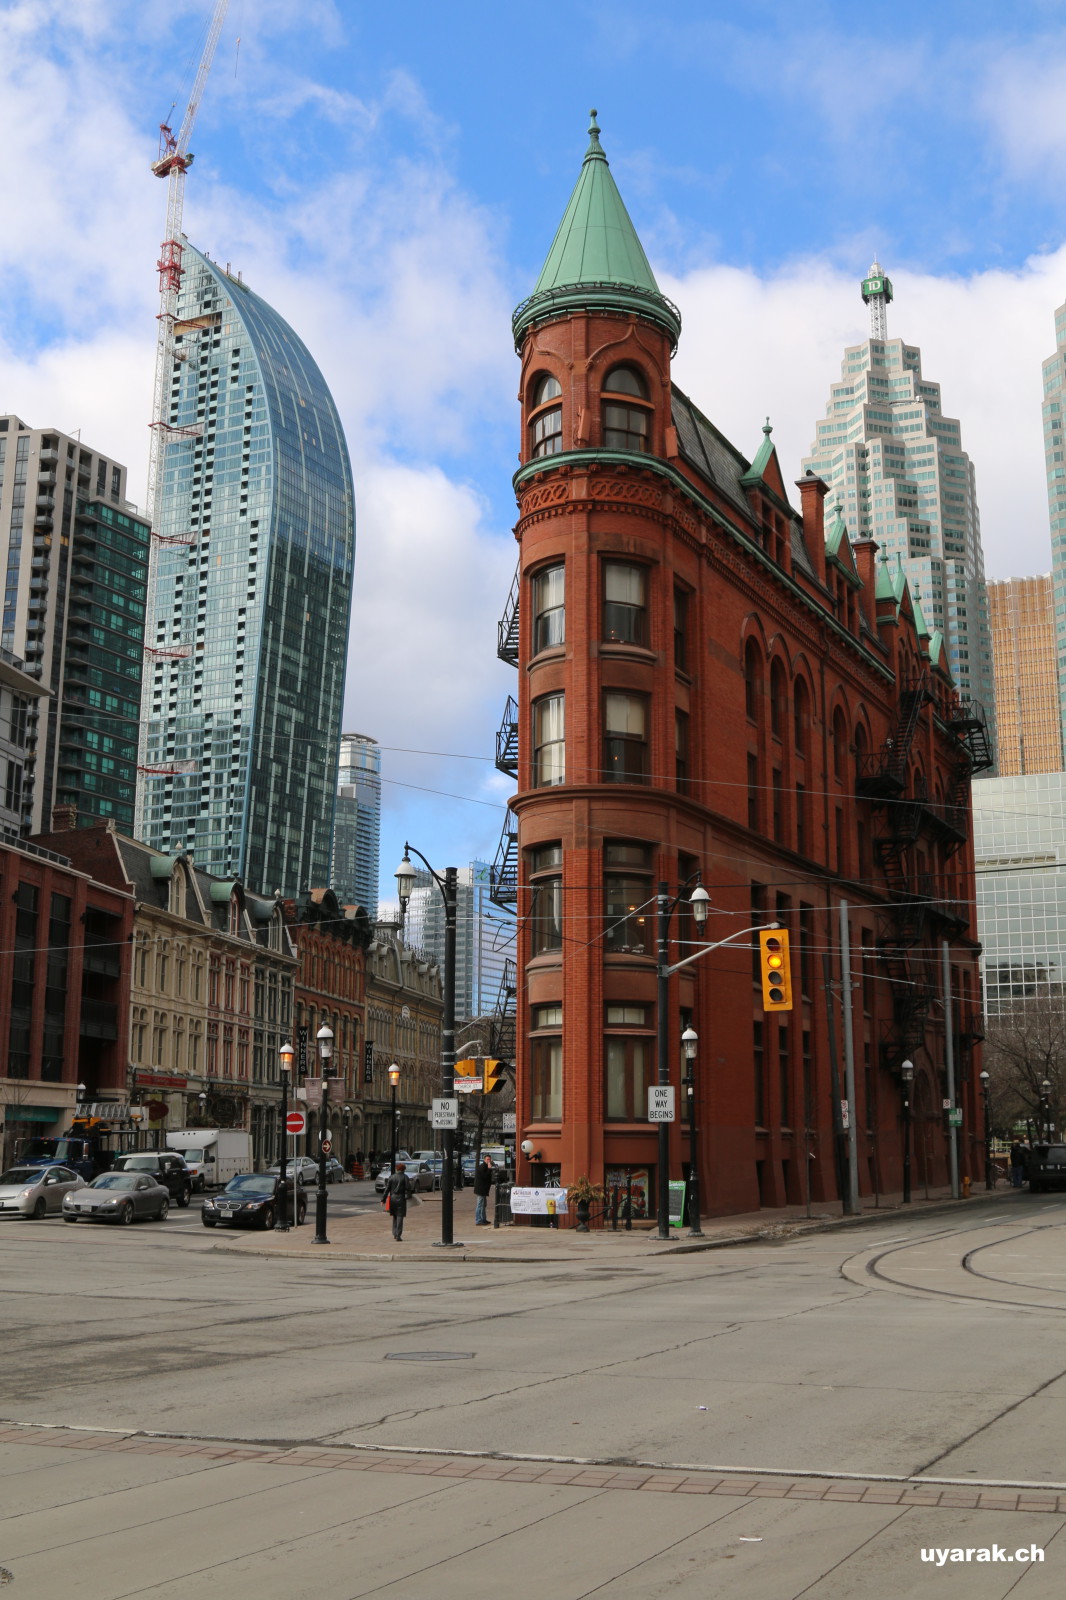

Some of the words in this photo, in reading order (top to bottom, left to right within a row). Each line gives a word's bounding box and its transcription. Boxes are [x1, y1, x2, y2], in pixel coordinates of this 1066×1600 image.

[866, 280, 881, 291] TD
[299, 1030, 307, 1072] WINNERS
[365, 1043, 373, 1081] WINNERS
[654, 1089, 668, 1098] ONE
[441, 1101, 450, 1110] NO
[655, 1100, 668, 1108] WAY
[649, 1110, 674, 1119] BEGINS
